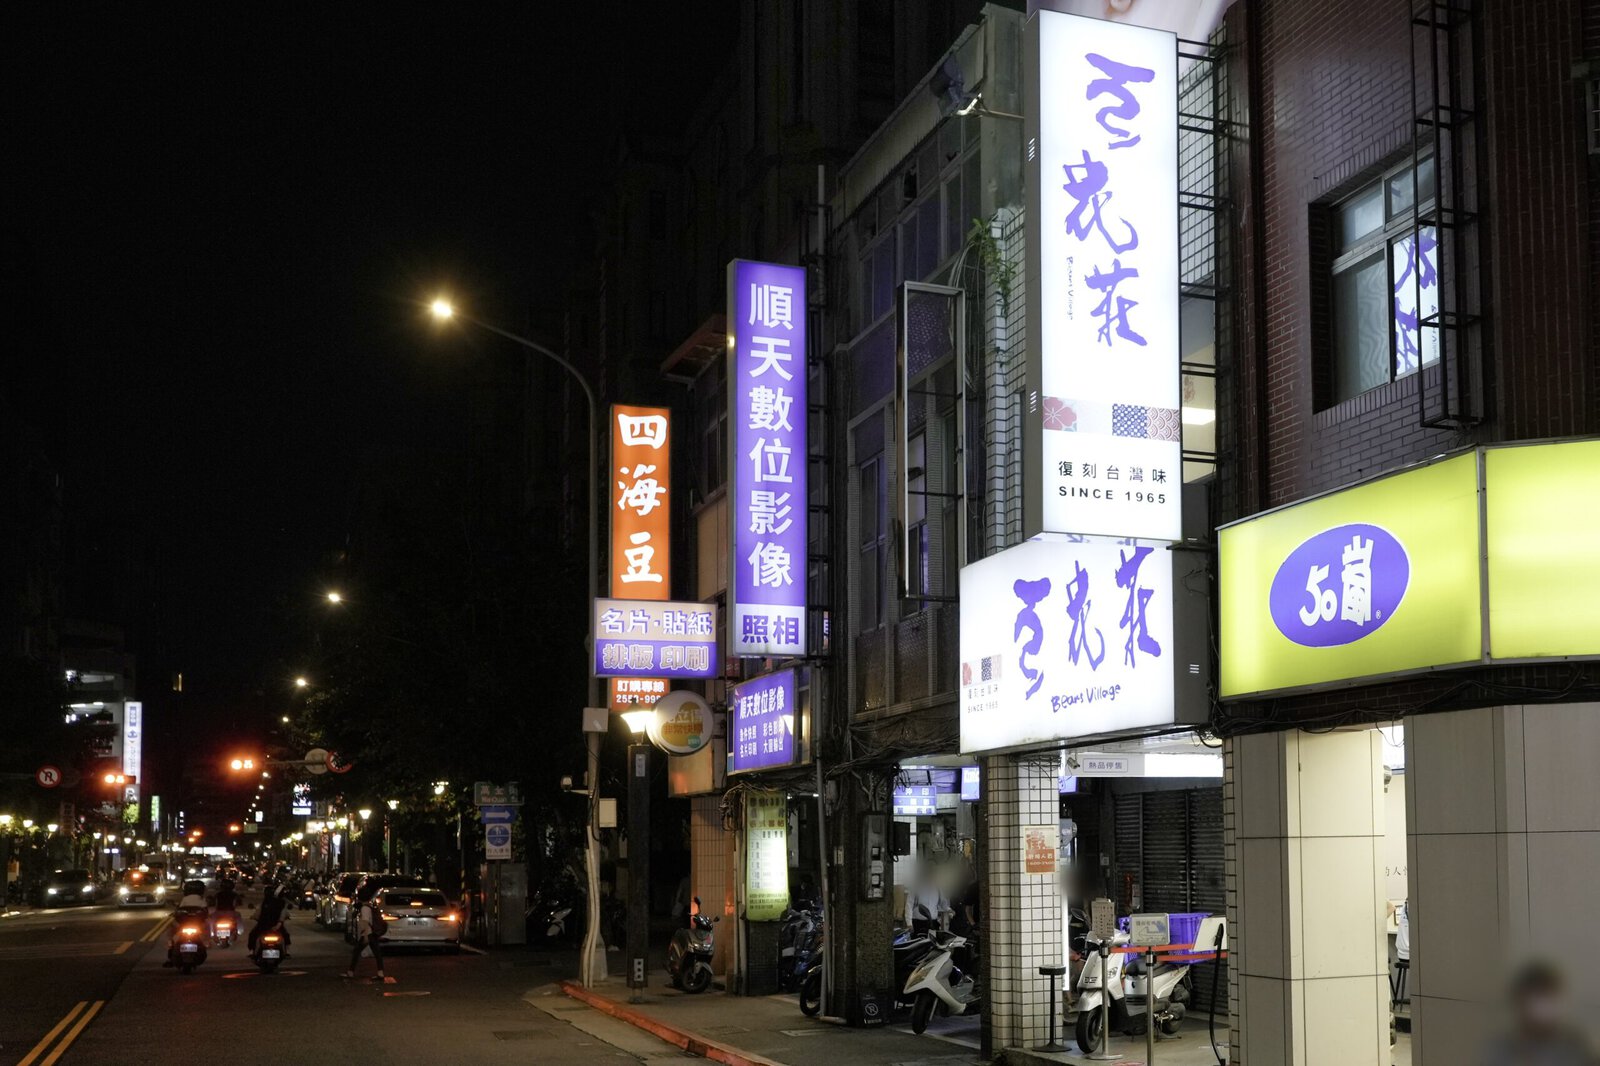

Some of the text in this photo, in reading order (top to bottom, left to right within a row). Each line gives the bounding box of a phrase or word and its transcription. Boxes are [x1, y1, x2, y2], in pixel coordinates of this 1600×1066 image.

[748, 282, 793, 588] 順天數位影像
[1058, 460, 1168, 484] 復刻台灣味
[617, 413, 668, 584] 四海豆
[1058, 485, 1168, 505] SINCE 1965
[742, 613, 799, 645] 照相
[602, 643, 709, 671] 排版 印刷
[739, 684, 785, 719] 順天數位影像
[1085, 684, 1122, 704] Village
